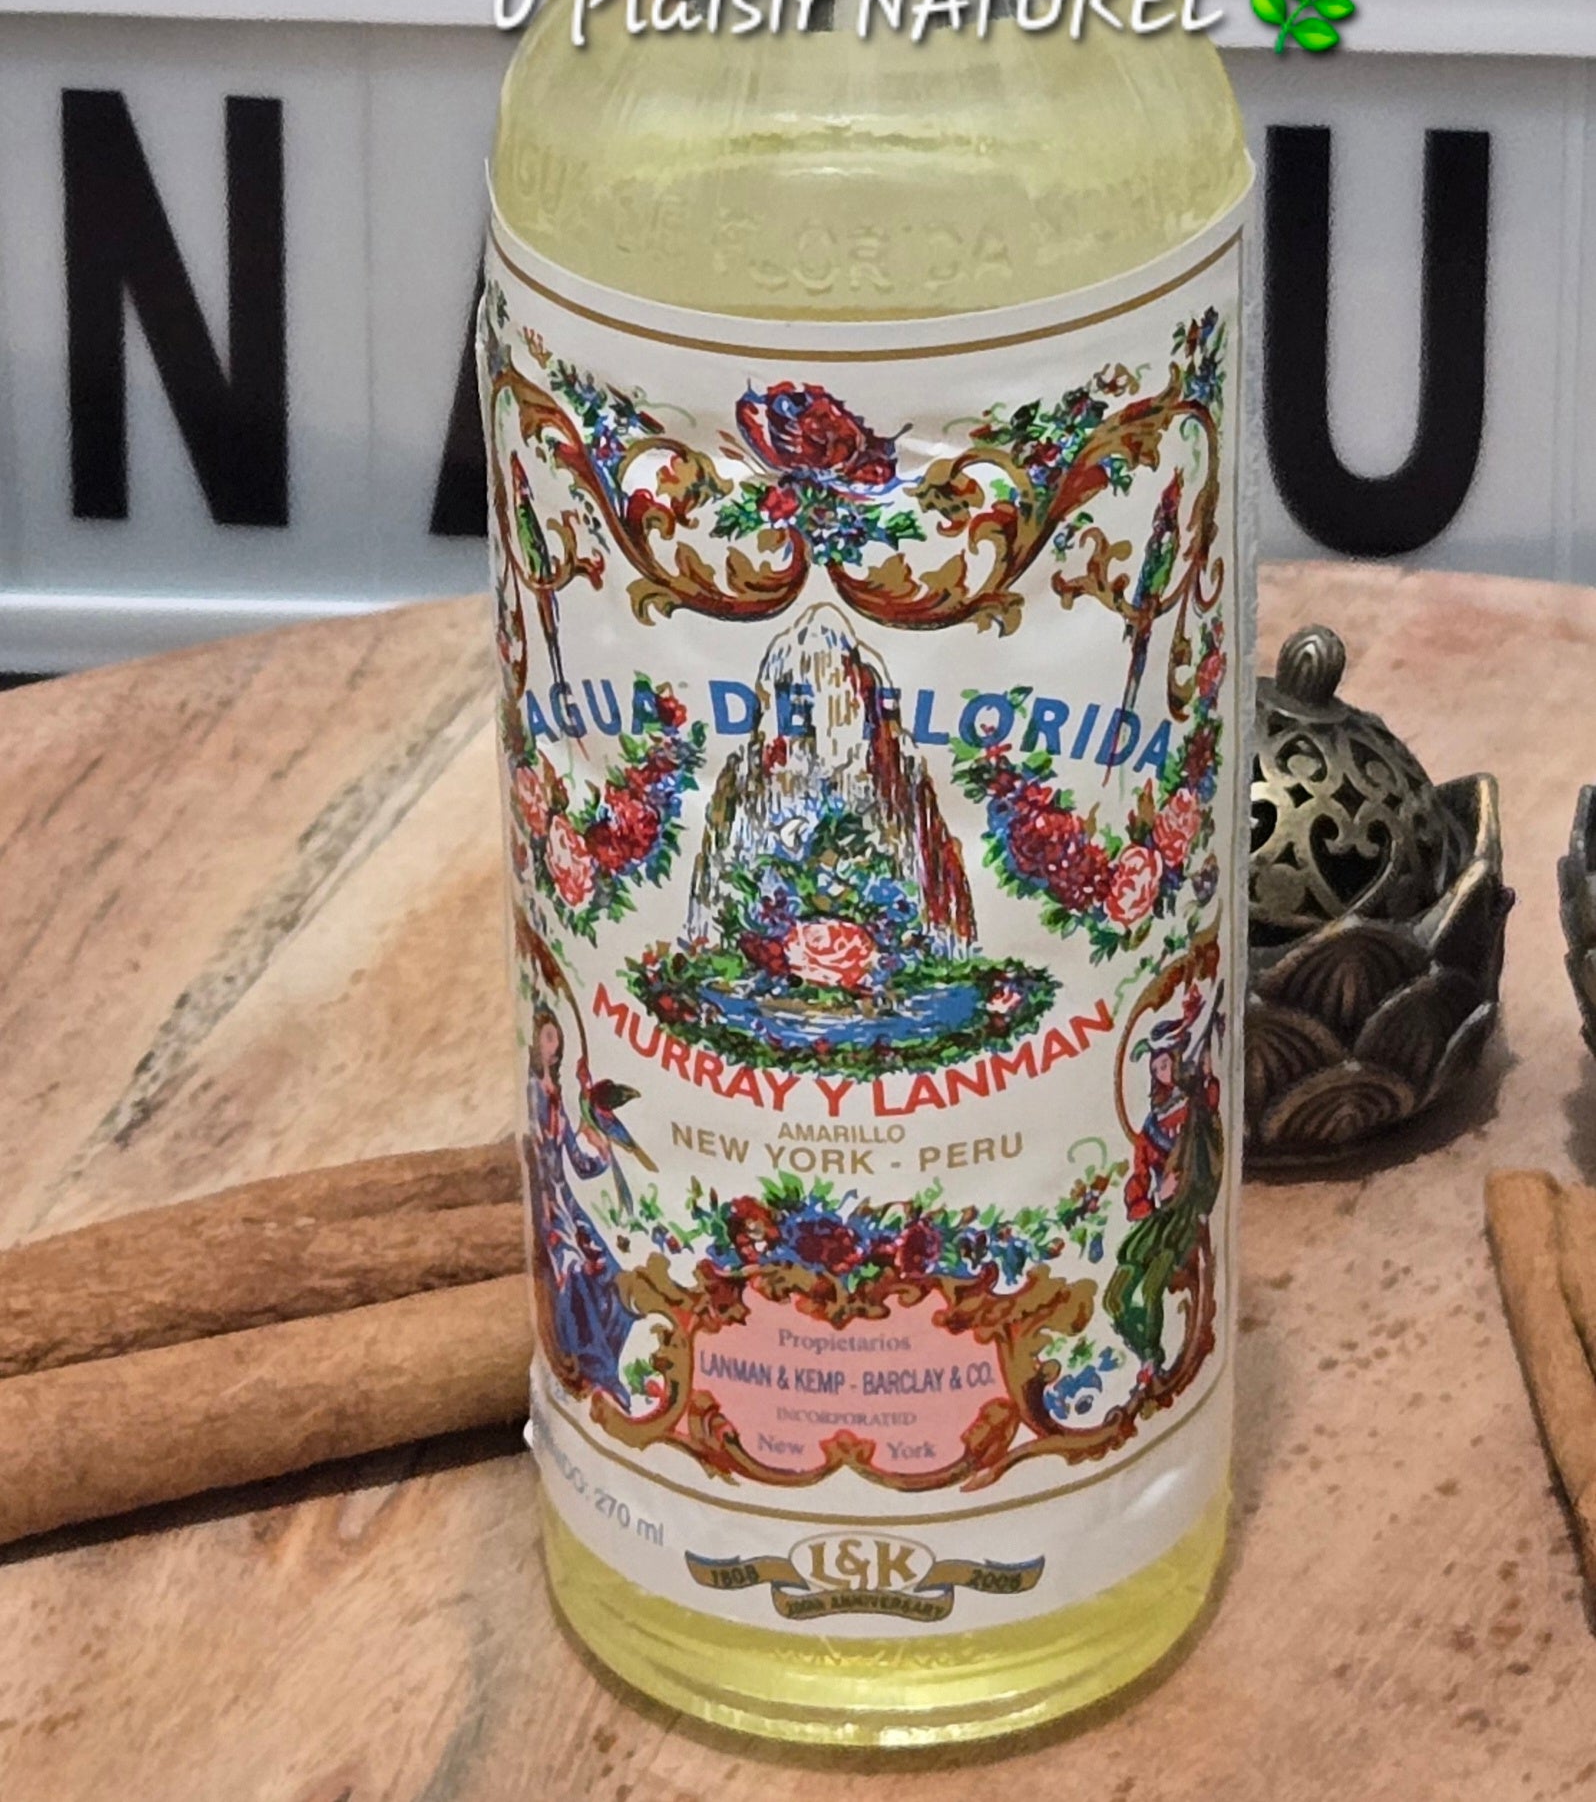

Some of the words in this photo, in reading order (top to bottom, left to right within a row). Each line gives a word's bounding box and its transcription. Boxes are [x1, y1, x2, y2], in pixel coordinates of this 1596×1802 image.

[525, 679, 662, 743] AGUA
[708, 680, 815, 736] DE
[592, 982, 801, 1113] MURRAY
[814, 1077, 854, 1118] Y
[872, 998, 1114, 1118] LANMAN
[670, 1121, 750, 1164] NEW
[764, 1142, 874, 1175] YORK
[918, 1131, 1023, 1172] PERU
[777, 1121, 907, 1144] AMARILLO
[778, 1328, 912, 1355] Propietarios
[699, 1349, 773, 1388] LANMAN
[776, 1364, 789, 1390] &
[794, 1368, 846, 1395] KEMP
[862, 1368, 946, 1396] BARCLAY
[948, 1365, 963, 1389] &
[966, 1359, 996, 1388] CO.
[775, 1406, 919, 1428] INCORPORATED
[756, 1432, 806, 1457] New
[886, 1441, 938, 1461] York
[593, 1488, 631, 1528] 270
[636, 1516, 664, 1547] ml
[807, 1536, 919, 1592] L&K
